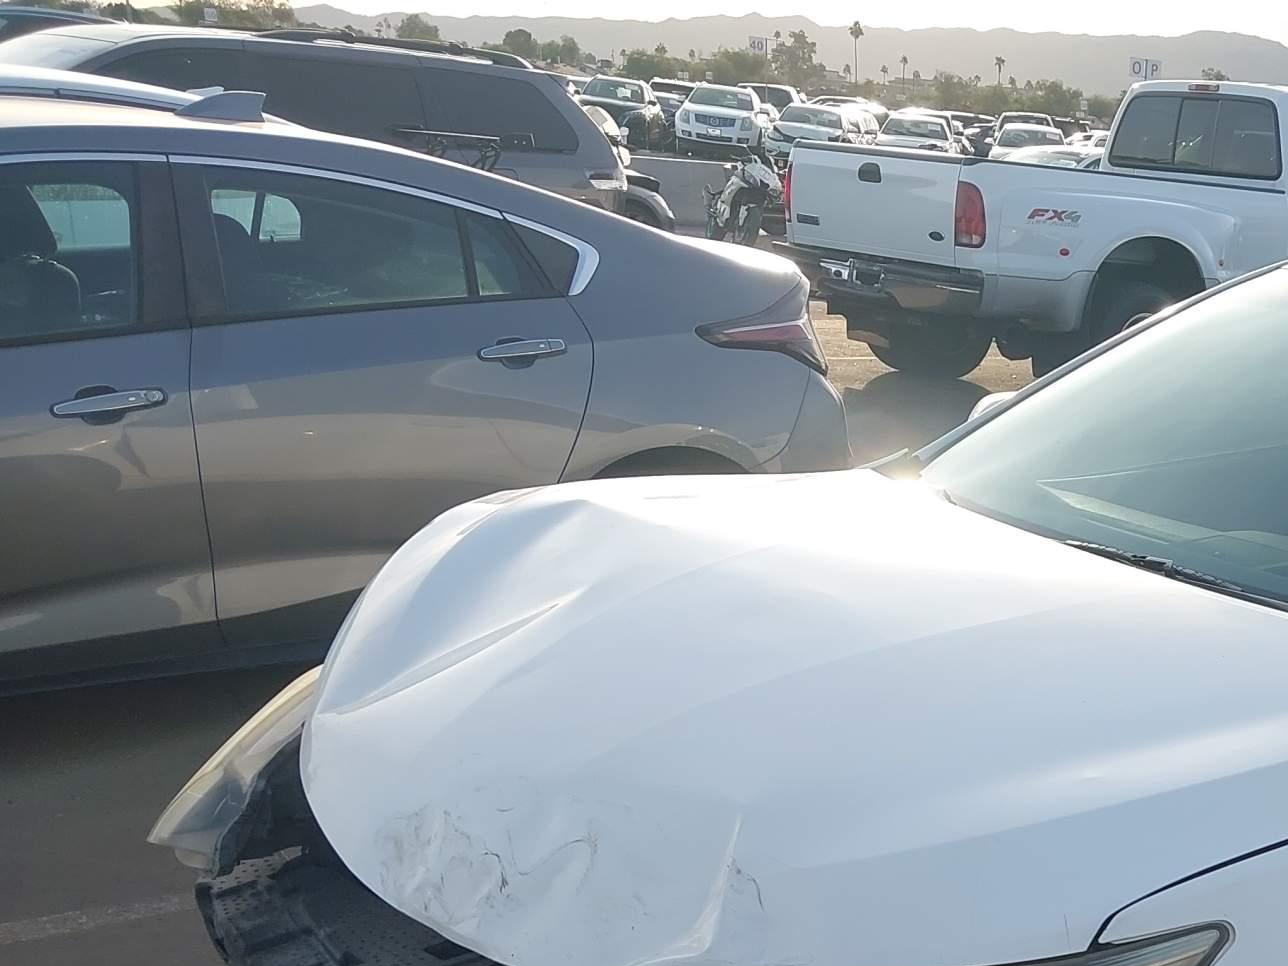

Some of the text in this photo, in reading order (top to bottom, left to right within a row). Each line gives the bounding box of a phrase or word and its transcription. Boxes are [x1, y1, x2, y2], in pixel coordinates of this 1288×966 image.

[750, 39, 764, 51] 40
[1151, 63, 1159, 76] P
[1027, 207, 1082, 223] FX4
